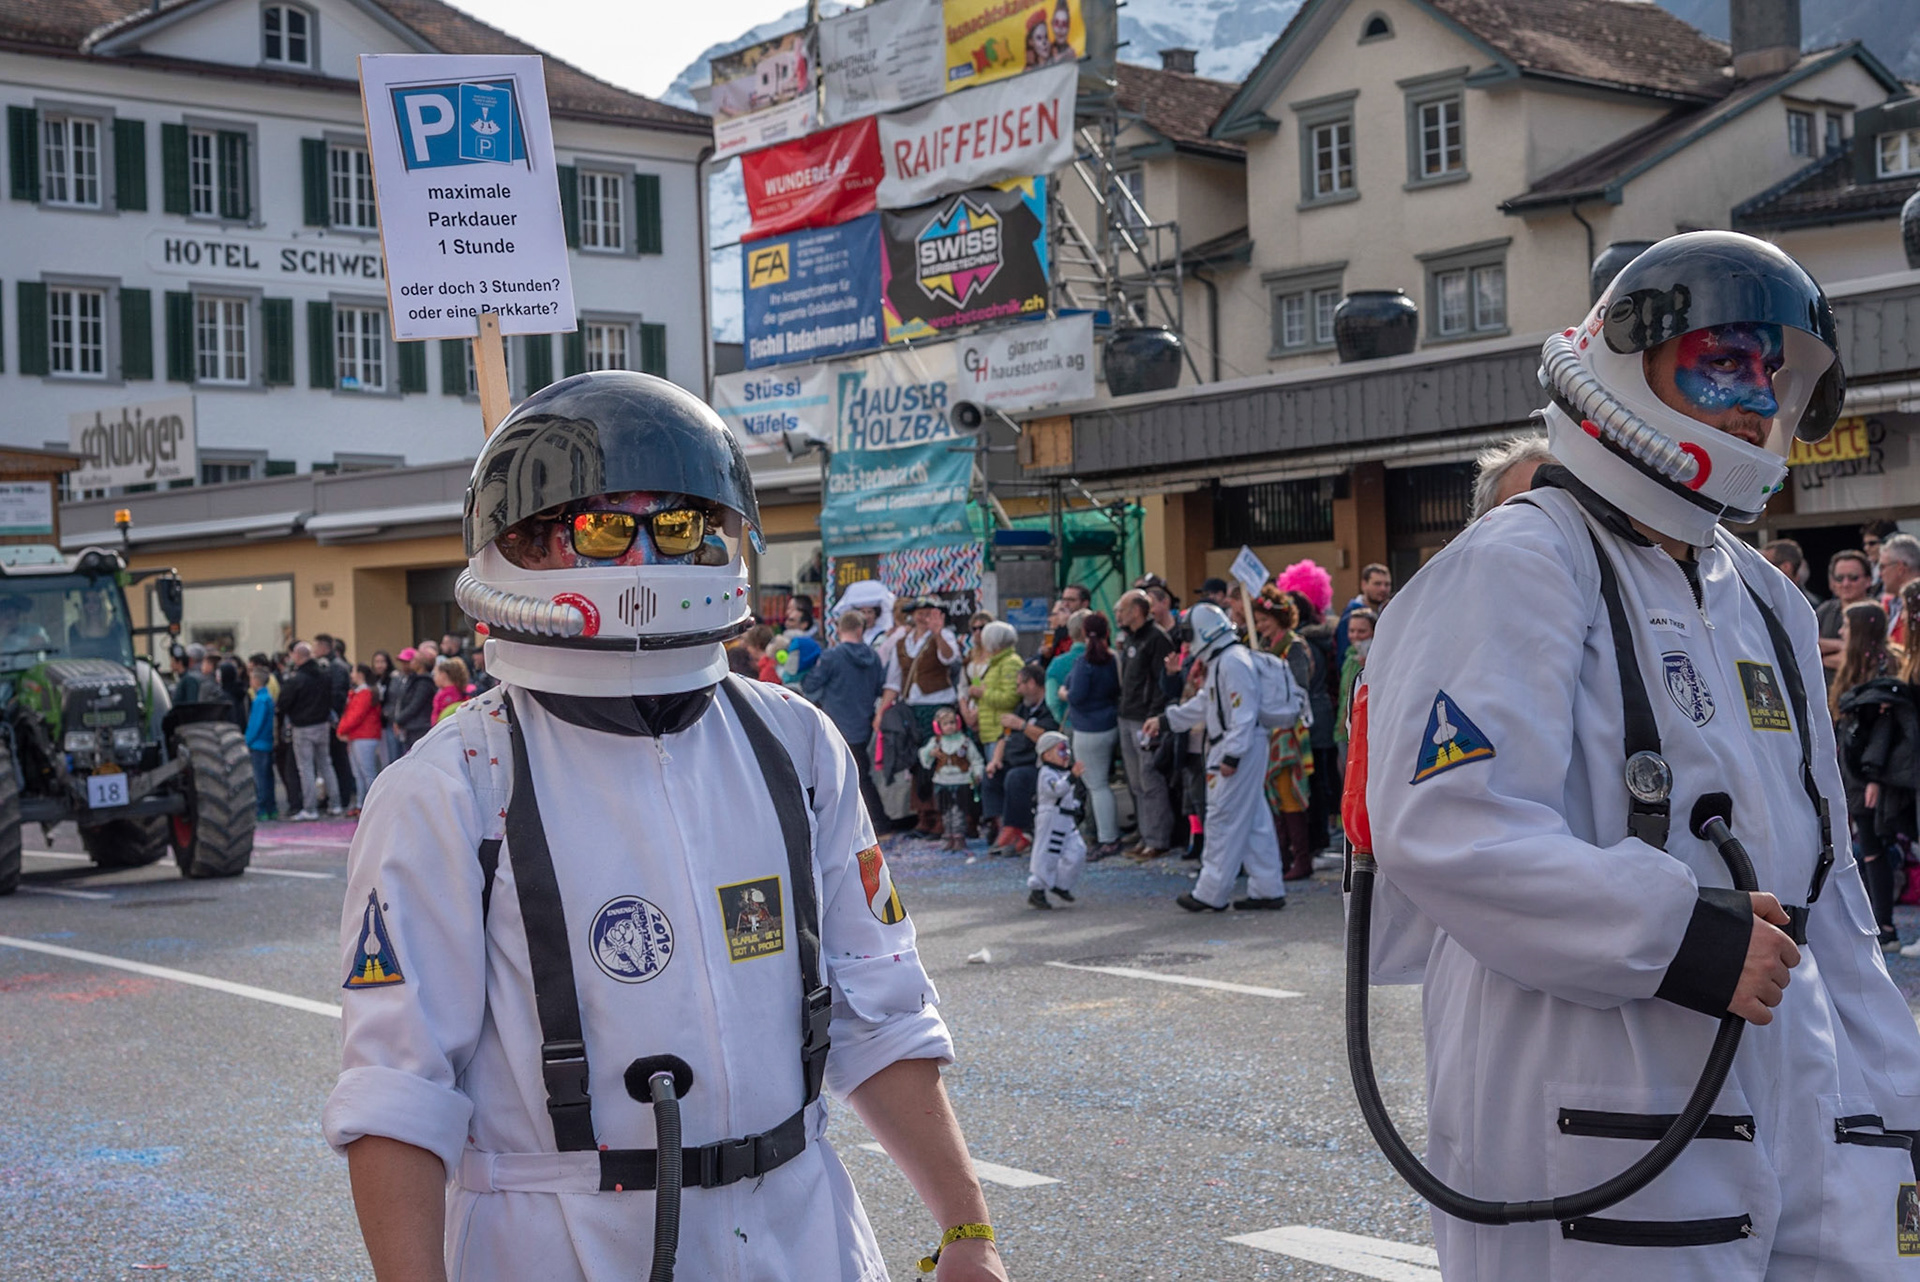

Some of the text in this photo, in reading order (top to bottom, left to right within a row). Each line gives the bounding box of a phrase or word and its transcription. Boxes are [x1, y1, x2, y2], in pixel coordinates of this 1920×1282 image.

[404, 93, 455, 162] P
[893, 98, 1060, 181] RAIFFEISEN
[480, 139, 492, 155] P
[428, 183, 511, 200] maximale
[428, 211, 518, 227] Parkdauer
[164, 238, 260, 270] HOTEL
[438, 238, 515, 255] 1 Stunde
[920, 226, 998, 265] SWISS
[751, 250, 787, 283] FA
[921, 251, 998, 278] WERBETECHNIK
[400, 278, 561, 296] oder doch 3 Stunden?
[408, 302, 559, 320] oder eine Parkkarte?
[786, 323, 858, 354] Bedachungen
[859, 315, 877, 340] AG
[1007, 338, 1049, 361] glarner
[990, 353, 1085, 380] haustechnik ag
[743, 376, 801, 402] Stüssi
[849, 380, 948, 420] HAUSER
[743, 412, 799, 437] Näfels
[850, 411, 955, 450] HOLZBA
[80, 406, 185, 478] schubiger
[97, 782, 121, 802] 18
[651, 912, 671, 955] 2019
[733, 946, 748, 957] GOT
[750, 945, 756, 954] A
